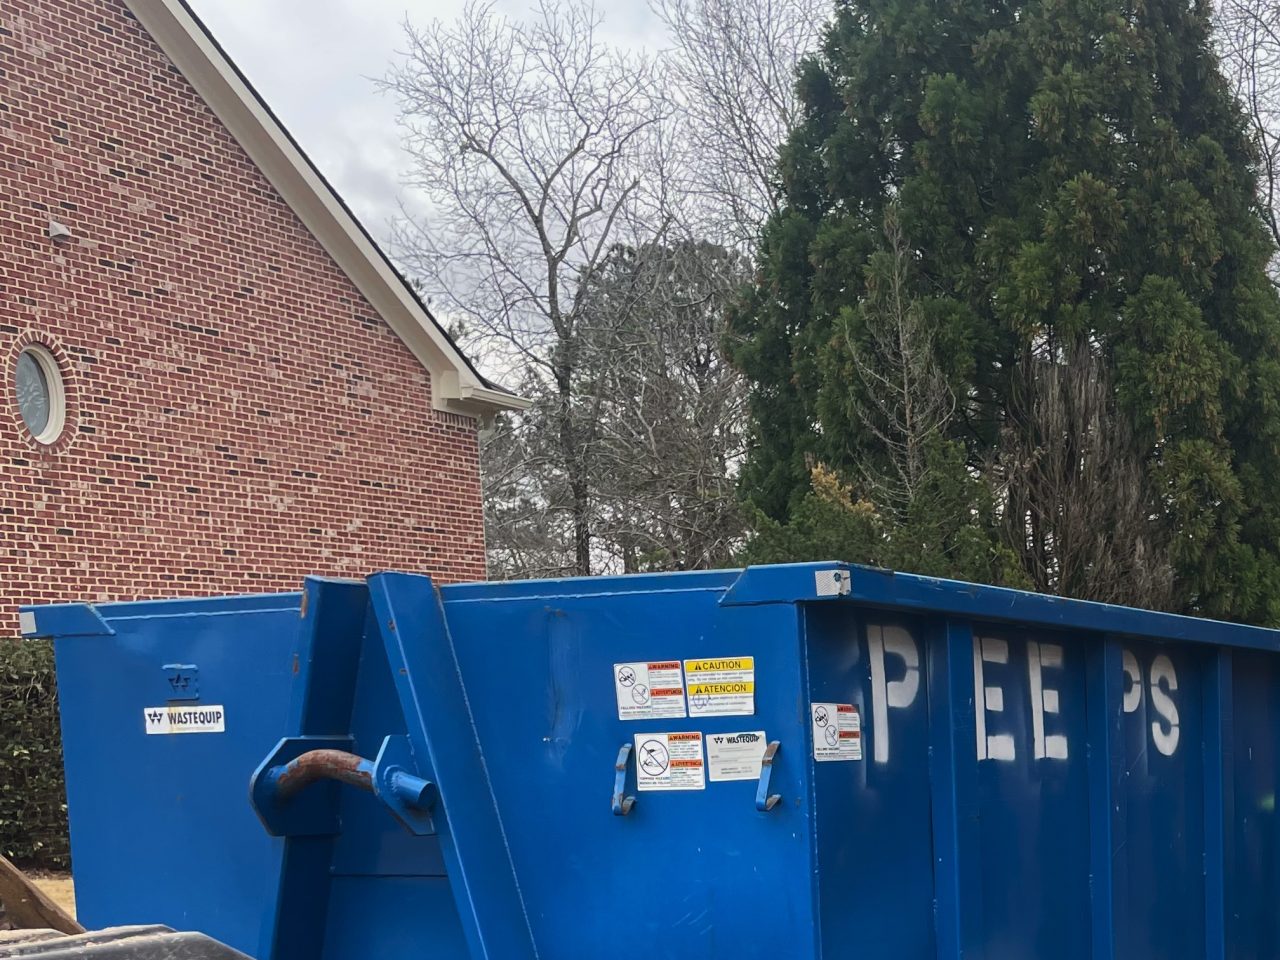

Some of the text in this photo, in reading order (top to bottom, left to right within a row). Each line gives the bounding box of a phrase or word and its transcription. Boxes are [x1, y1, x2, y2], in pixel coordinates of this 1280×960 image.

[702, 660, 741, 670] CAUTION
[167, 711, 222, 725] WASTEQUIP
[726, 734, 760, 744] WASTEQUIP
